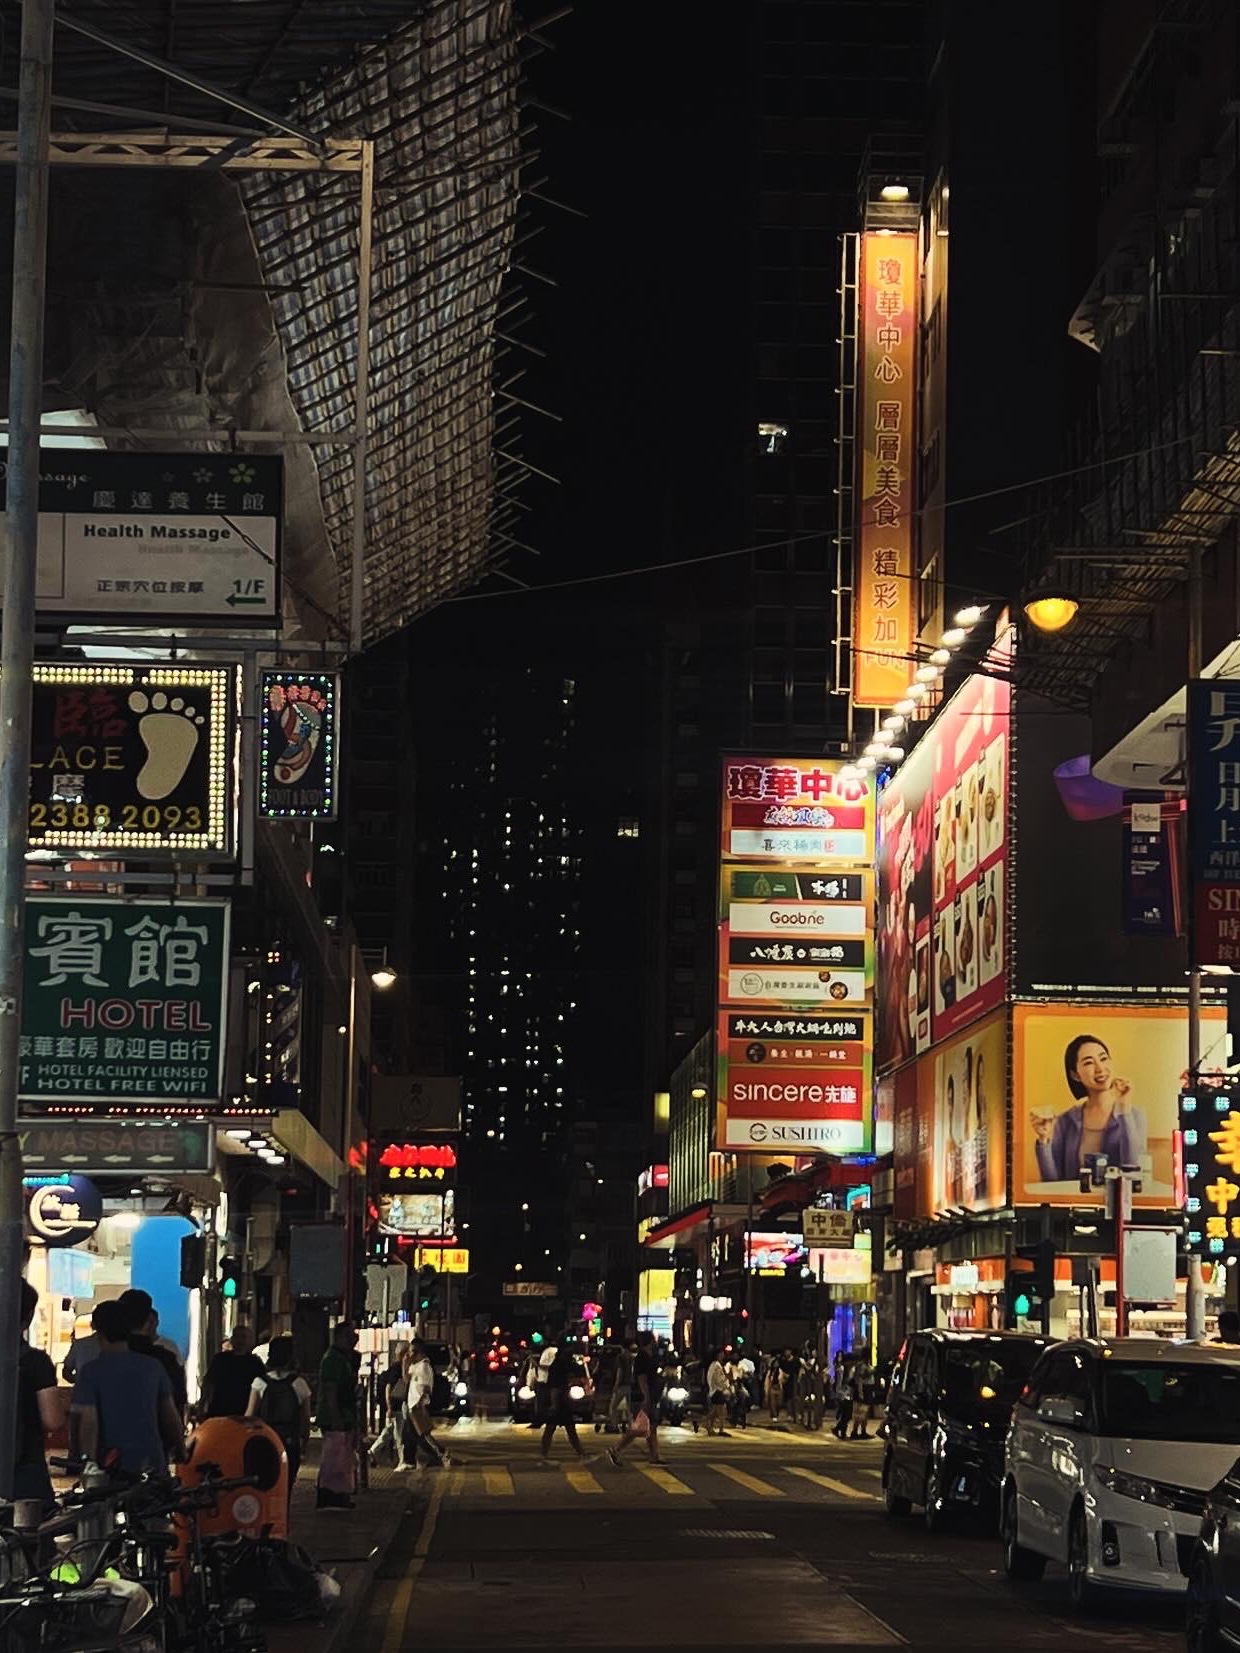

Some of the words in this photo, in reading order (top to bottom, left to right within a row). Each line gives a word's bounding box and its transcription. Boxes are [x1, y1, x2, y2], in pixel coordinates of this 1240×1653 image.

[874, 256, 903, 384] 瓊華中心
[873, 399, 901, 528] 層層美食
[83, 523, 144, 538] Health
[150, 524, 232, 542] Massage
[232, 579, 266, 595] 1/F
[872, 547, 901, 643] 精彩加
[29, 803, 112, 830] 2388
[121, 804, 203, 831] 2093
[769, 910, 825, 926] Goobne
[27, 911, 209, 989] 賓館
[60, 996, 213, 1032] HOTEL
[104, 1037, 213, 1063] 歡迎自由行
[37, 1063, 84, 1077] HOTEL
[87, 1064, 148, 1078] FACILITY
[151, 1066, 209, 1079] LIENSED
[37, 1078, 106, 1091] HOTEL
[110, 1079, 156, 1092] FREE
[162, 1080, 207, 1094] WIFI
[733, 1082, 824, 1103] sincere
[824, 1084, 857, 1104] 先施
[37, 1130, 177, 1152] MASSAGE
[772, 1125, 842, 1141] SUSHIRO
